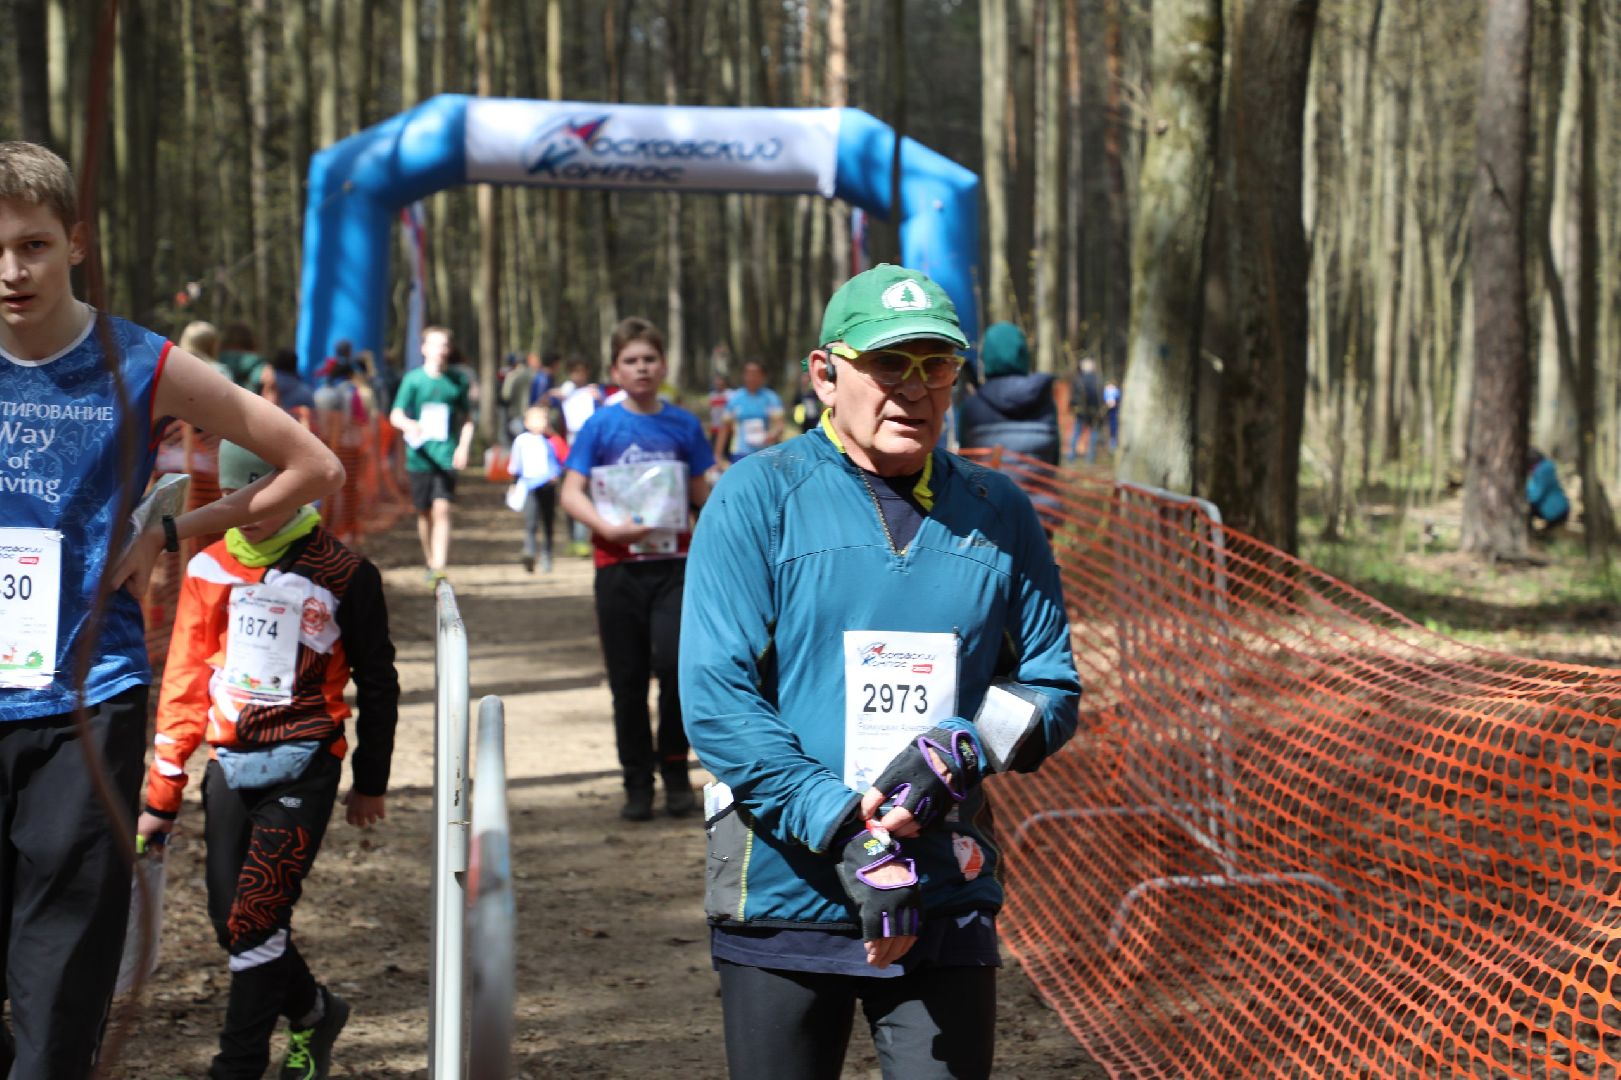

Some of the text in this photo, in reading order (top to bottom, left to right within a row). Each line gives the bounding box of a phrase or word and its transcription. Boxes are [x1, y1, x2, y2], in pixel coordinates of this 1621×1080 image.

[7, 449, 34, 470] of
[0, 574, 33, 601] 30
[237, 614, 280, 640] 1874
[862, 683, 928, 715] 2973
